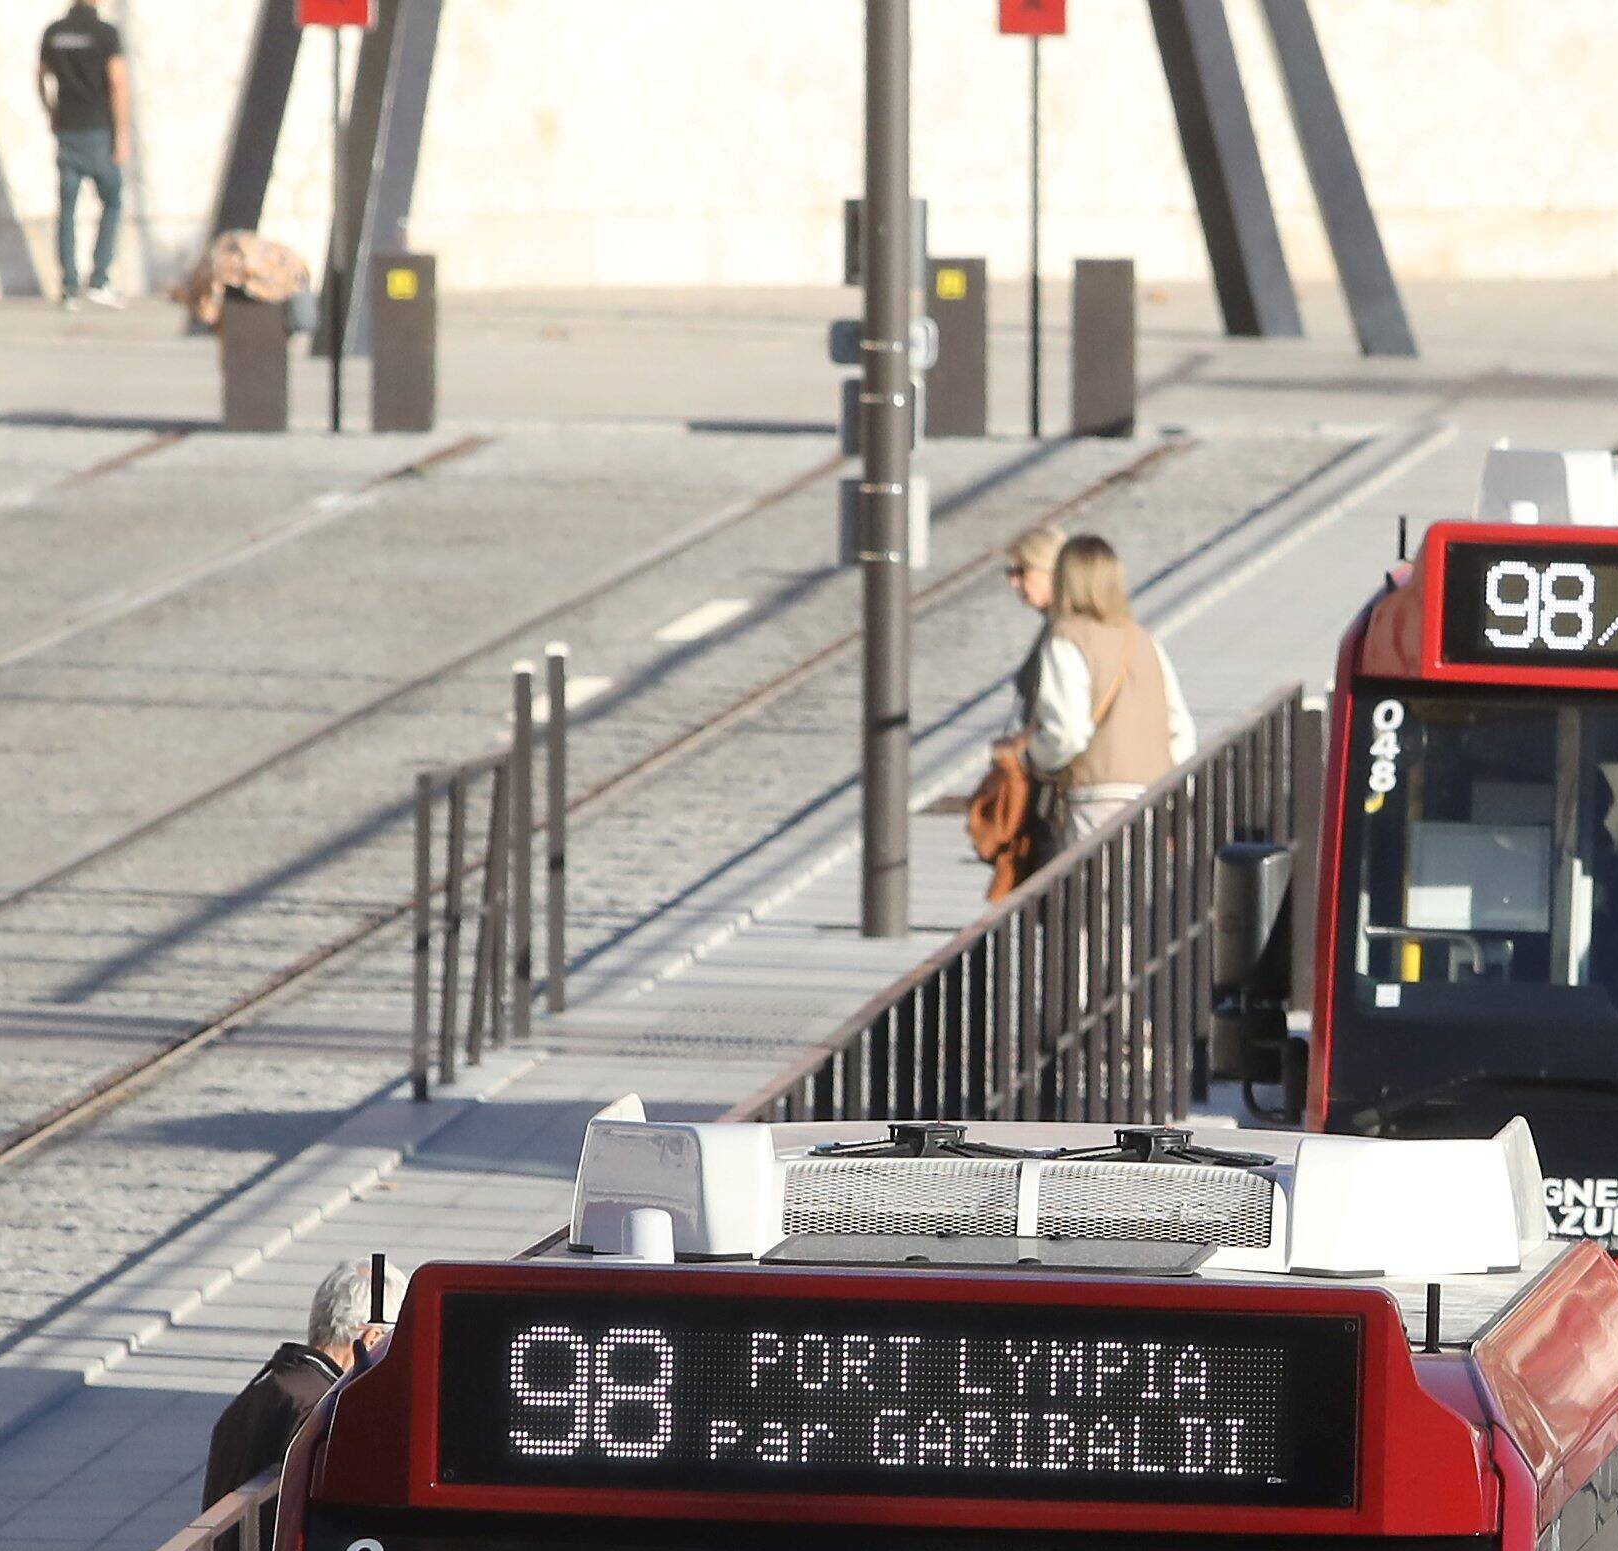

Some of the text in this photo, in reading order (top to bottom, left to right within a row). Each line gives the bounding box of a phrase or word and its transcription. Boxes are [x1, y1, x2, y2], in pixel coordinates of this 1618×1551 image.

[1483, 560, 1594, 651] 98
[1368, 699, 1405, 793] 048
[508, 1325, 675, 1459] 98
[749, 1331, 1211, 1401] PORT LYMPIA
[709, 1408, 1247, 1476] par GARIBALDI
